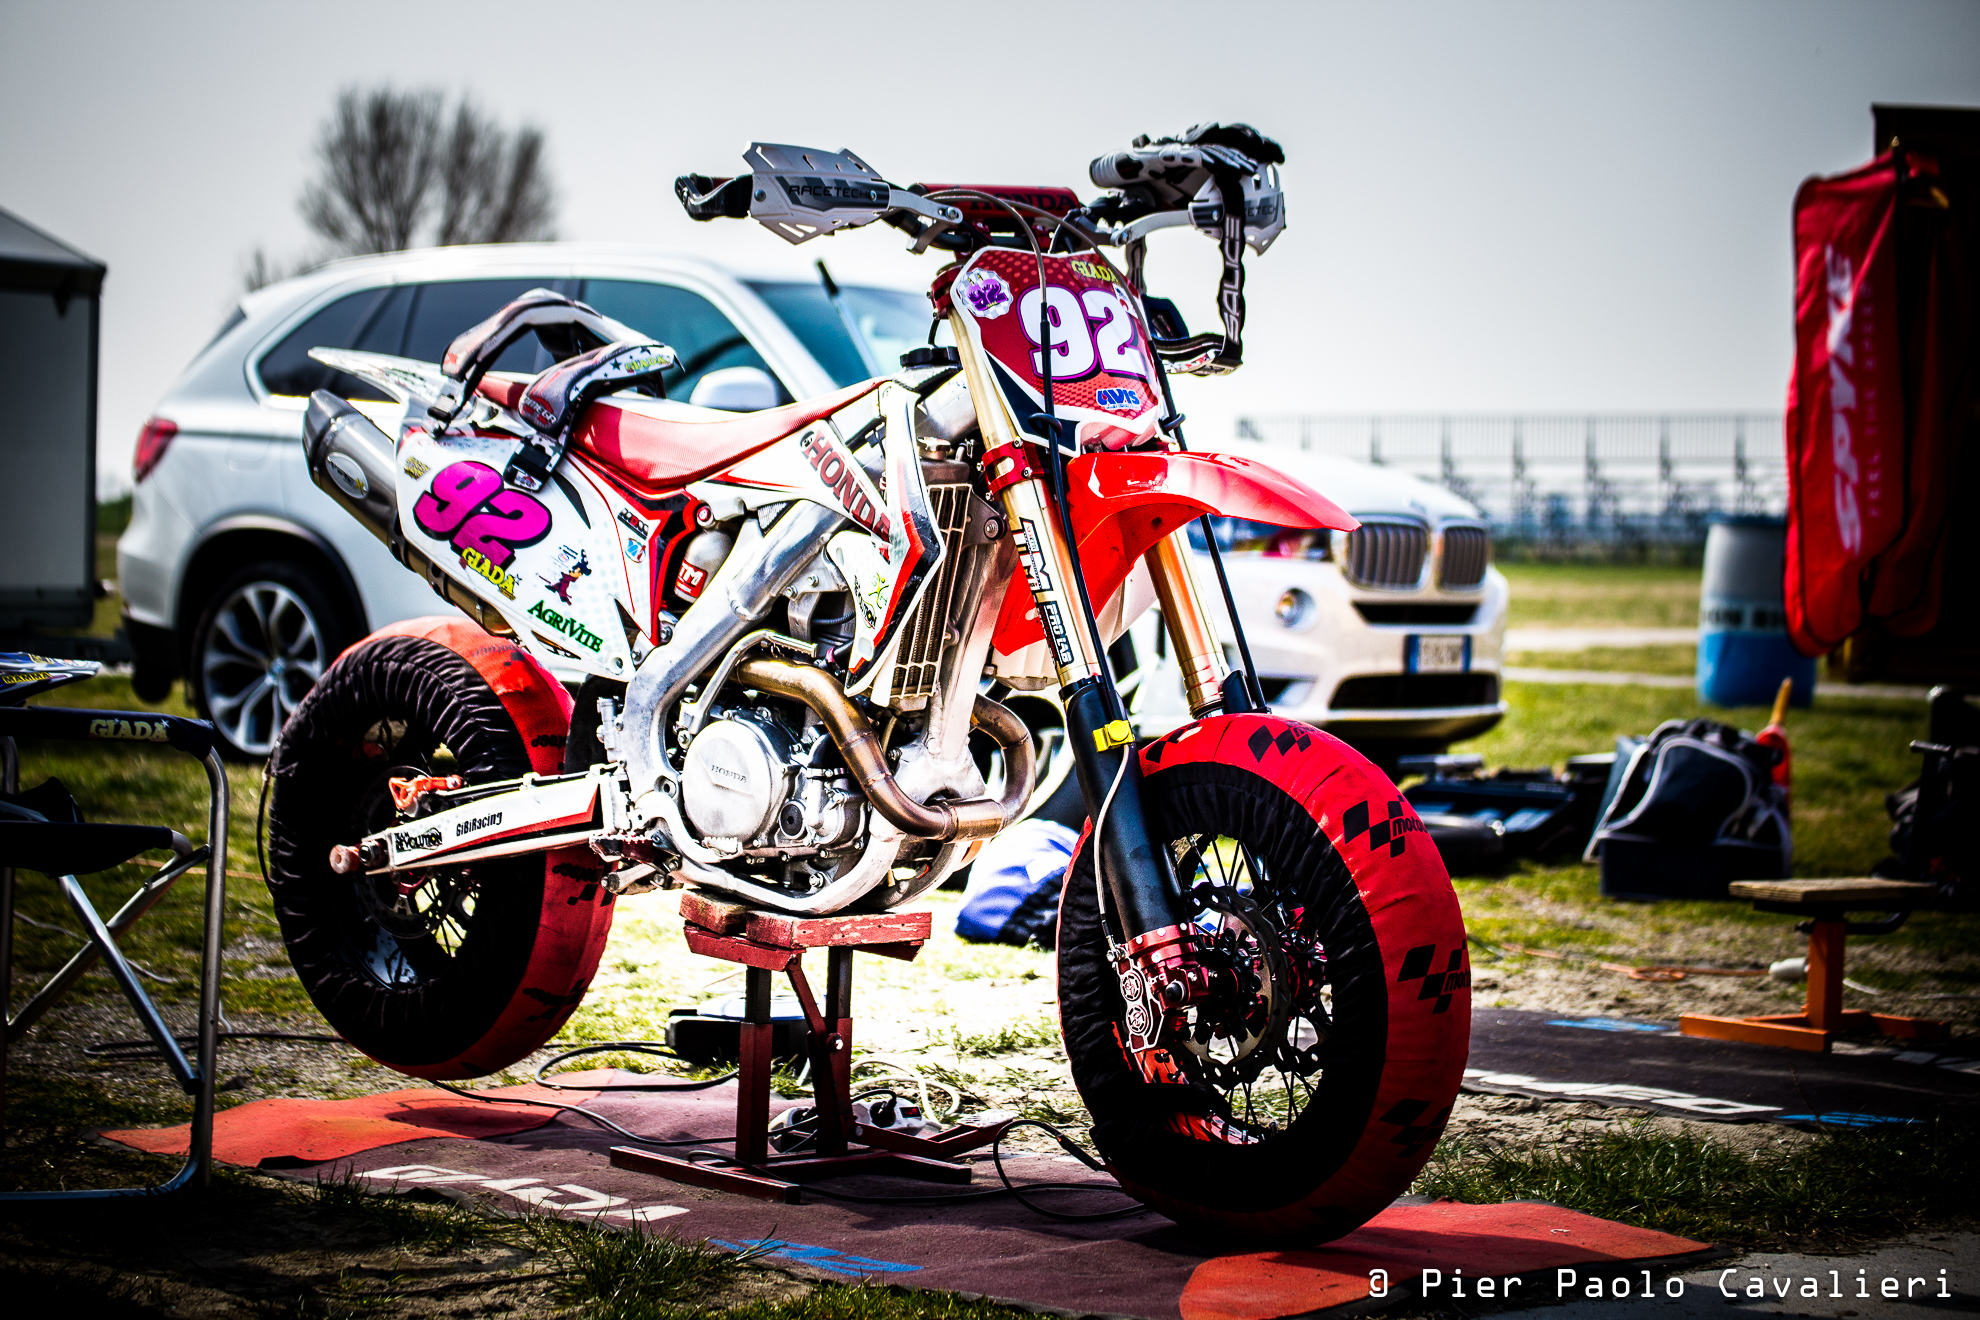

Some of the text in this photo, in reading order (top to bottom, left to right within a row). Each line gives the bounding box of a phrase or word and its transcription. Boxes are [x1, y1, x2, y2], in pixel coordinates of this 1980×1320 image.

[788, 184, 871, 200] RACETECH
[969, 192, 1080, 212] HONDA
[1071, 260, 1119, 283] GIADA
[1222, 217, 1243, 344] SALICE
[1017, 285, 1149, 382] 92
[625, 356, 667, 371] GIADA
[802, 430, 891, 563] HONDA
[413, 461, 553, 570] 92
[462, 547, 517, 594] GIADA
[1046, 603, 1074, 664] PRO LAB
[3, 672, 51, 684] MAMMA
[89, 719, 169, 741] GIADA
[711, 764, 747, 784] HONDA
